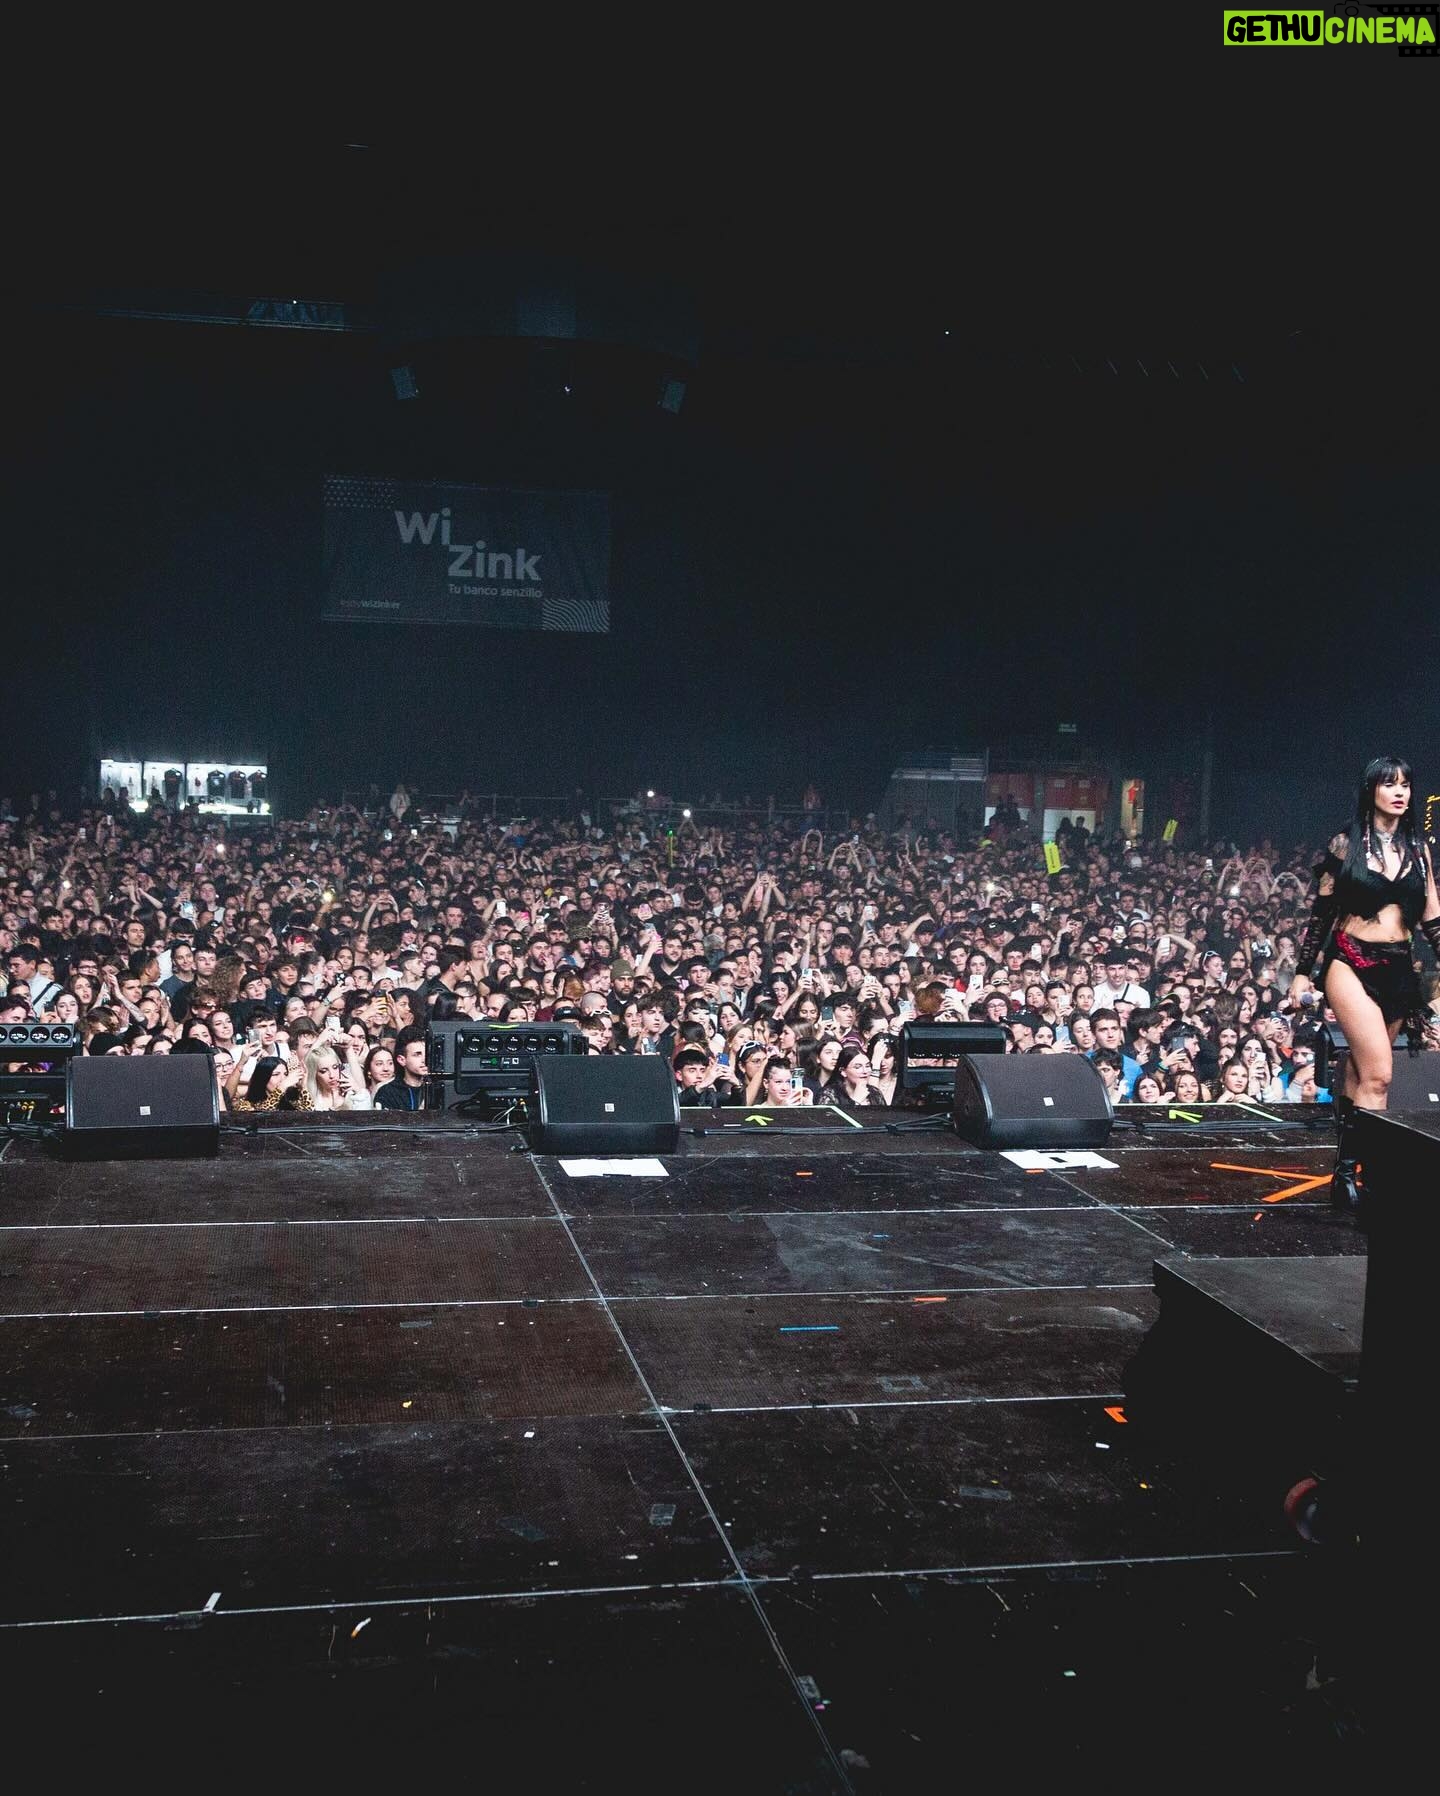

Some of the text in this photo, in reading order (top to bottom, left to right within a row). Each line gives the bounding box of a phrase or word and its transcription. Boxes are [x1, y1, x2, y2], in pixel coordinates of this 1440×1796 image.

[394, 507, 451, 545] Wi
[447, 540, 543, 581] Zink
[448, 583, 461, 594] Tu
[463, 584, 498, 596] banco
